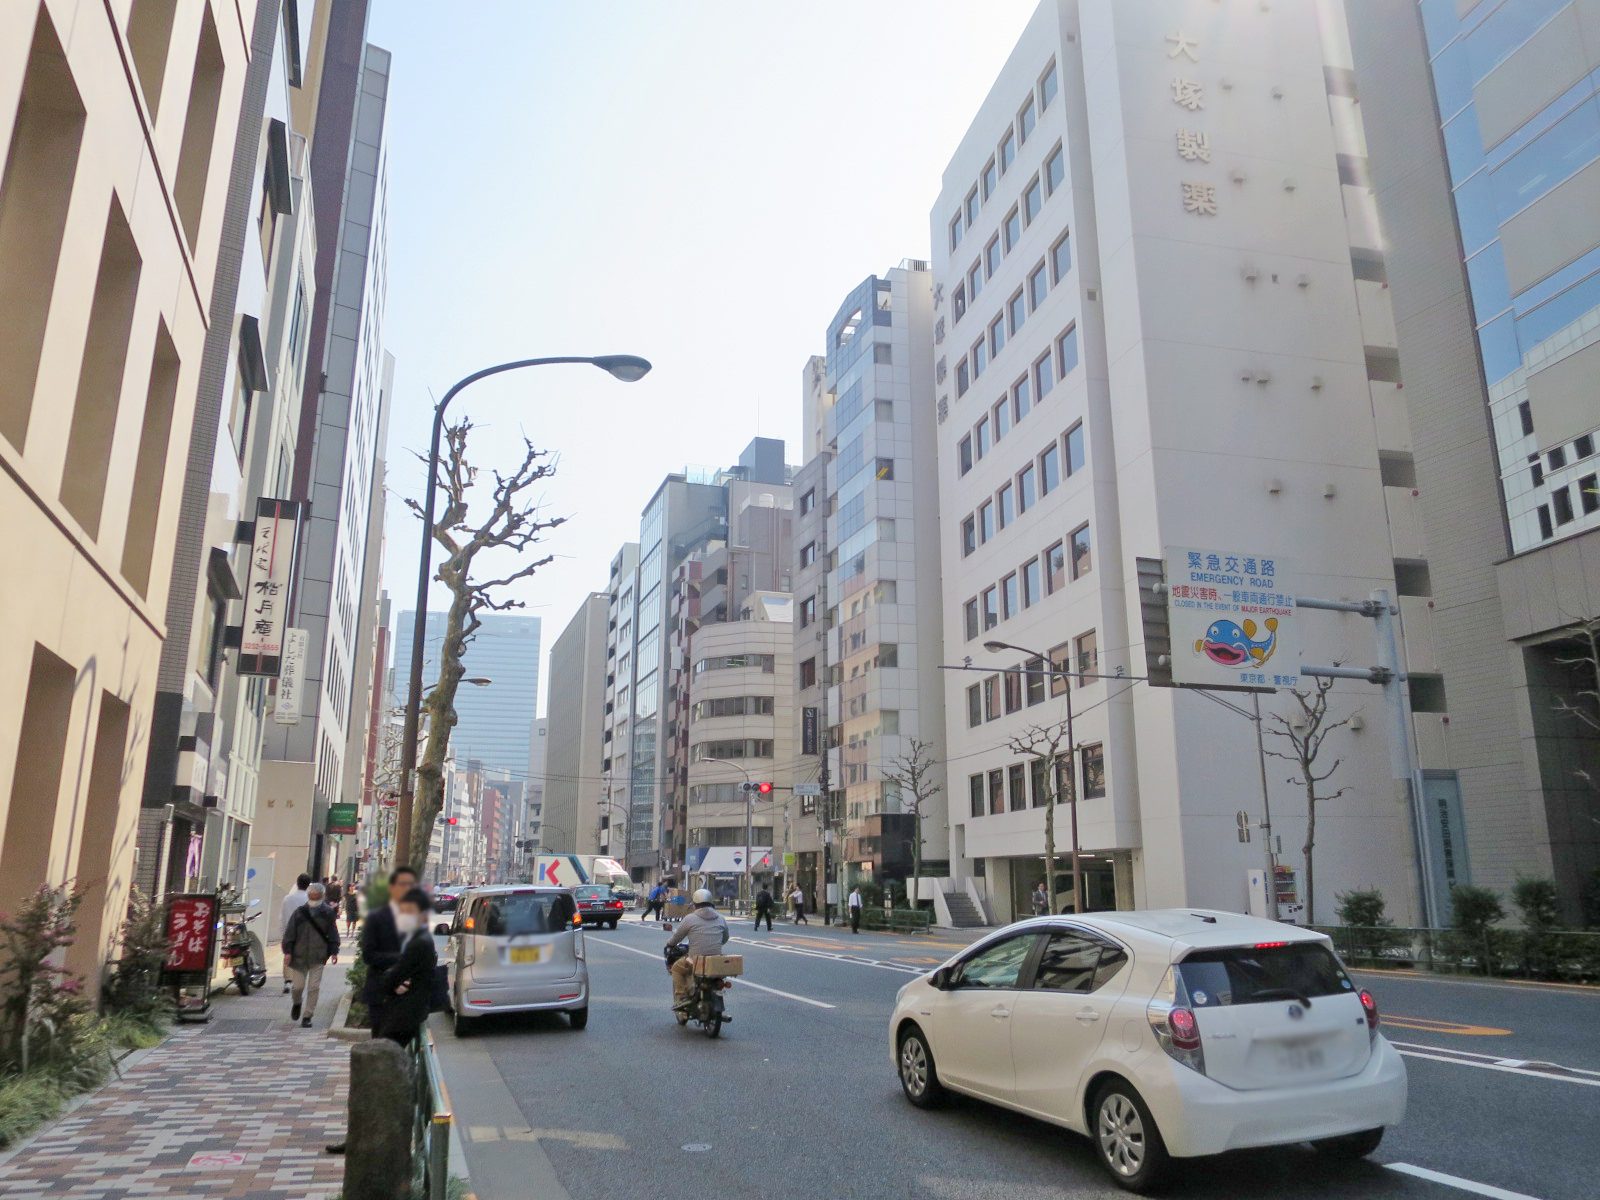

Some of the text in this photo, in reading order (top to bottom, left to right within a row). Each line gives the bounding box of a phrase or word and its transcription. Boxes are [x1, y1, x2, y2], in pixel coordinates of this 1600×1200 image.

[1164, 29, 1217, 216] 大塚製薬
[1187, 551, 1275, 577] 緊急交通路
[1190, 571, 1274, 588] EMERGENCY ROAD
[1174, 599, 1195, 608] CLOSED
[1203, 602, 1214, 610] THE
[1215, 603, 1231, 611] EVENT
[1232, 604, 1240, 612] OF
[1241, 605, 1259, 613] MAJOR
[1259, 606, 1292, 616] EARTHQUAKE
[280, 632, 297, 700] よしだ葬儀社
[188, 902, 210, 953] おそば
